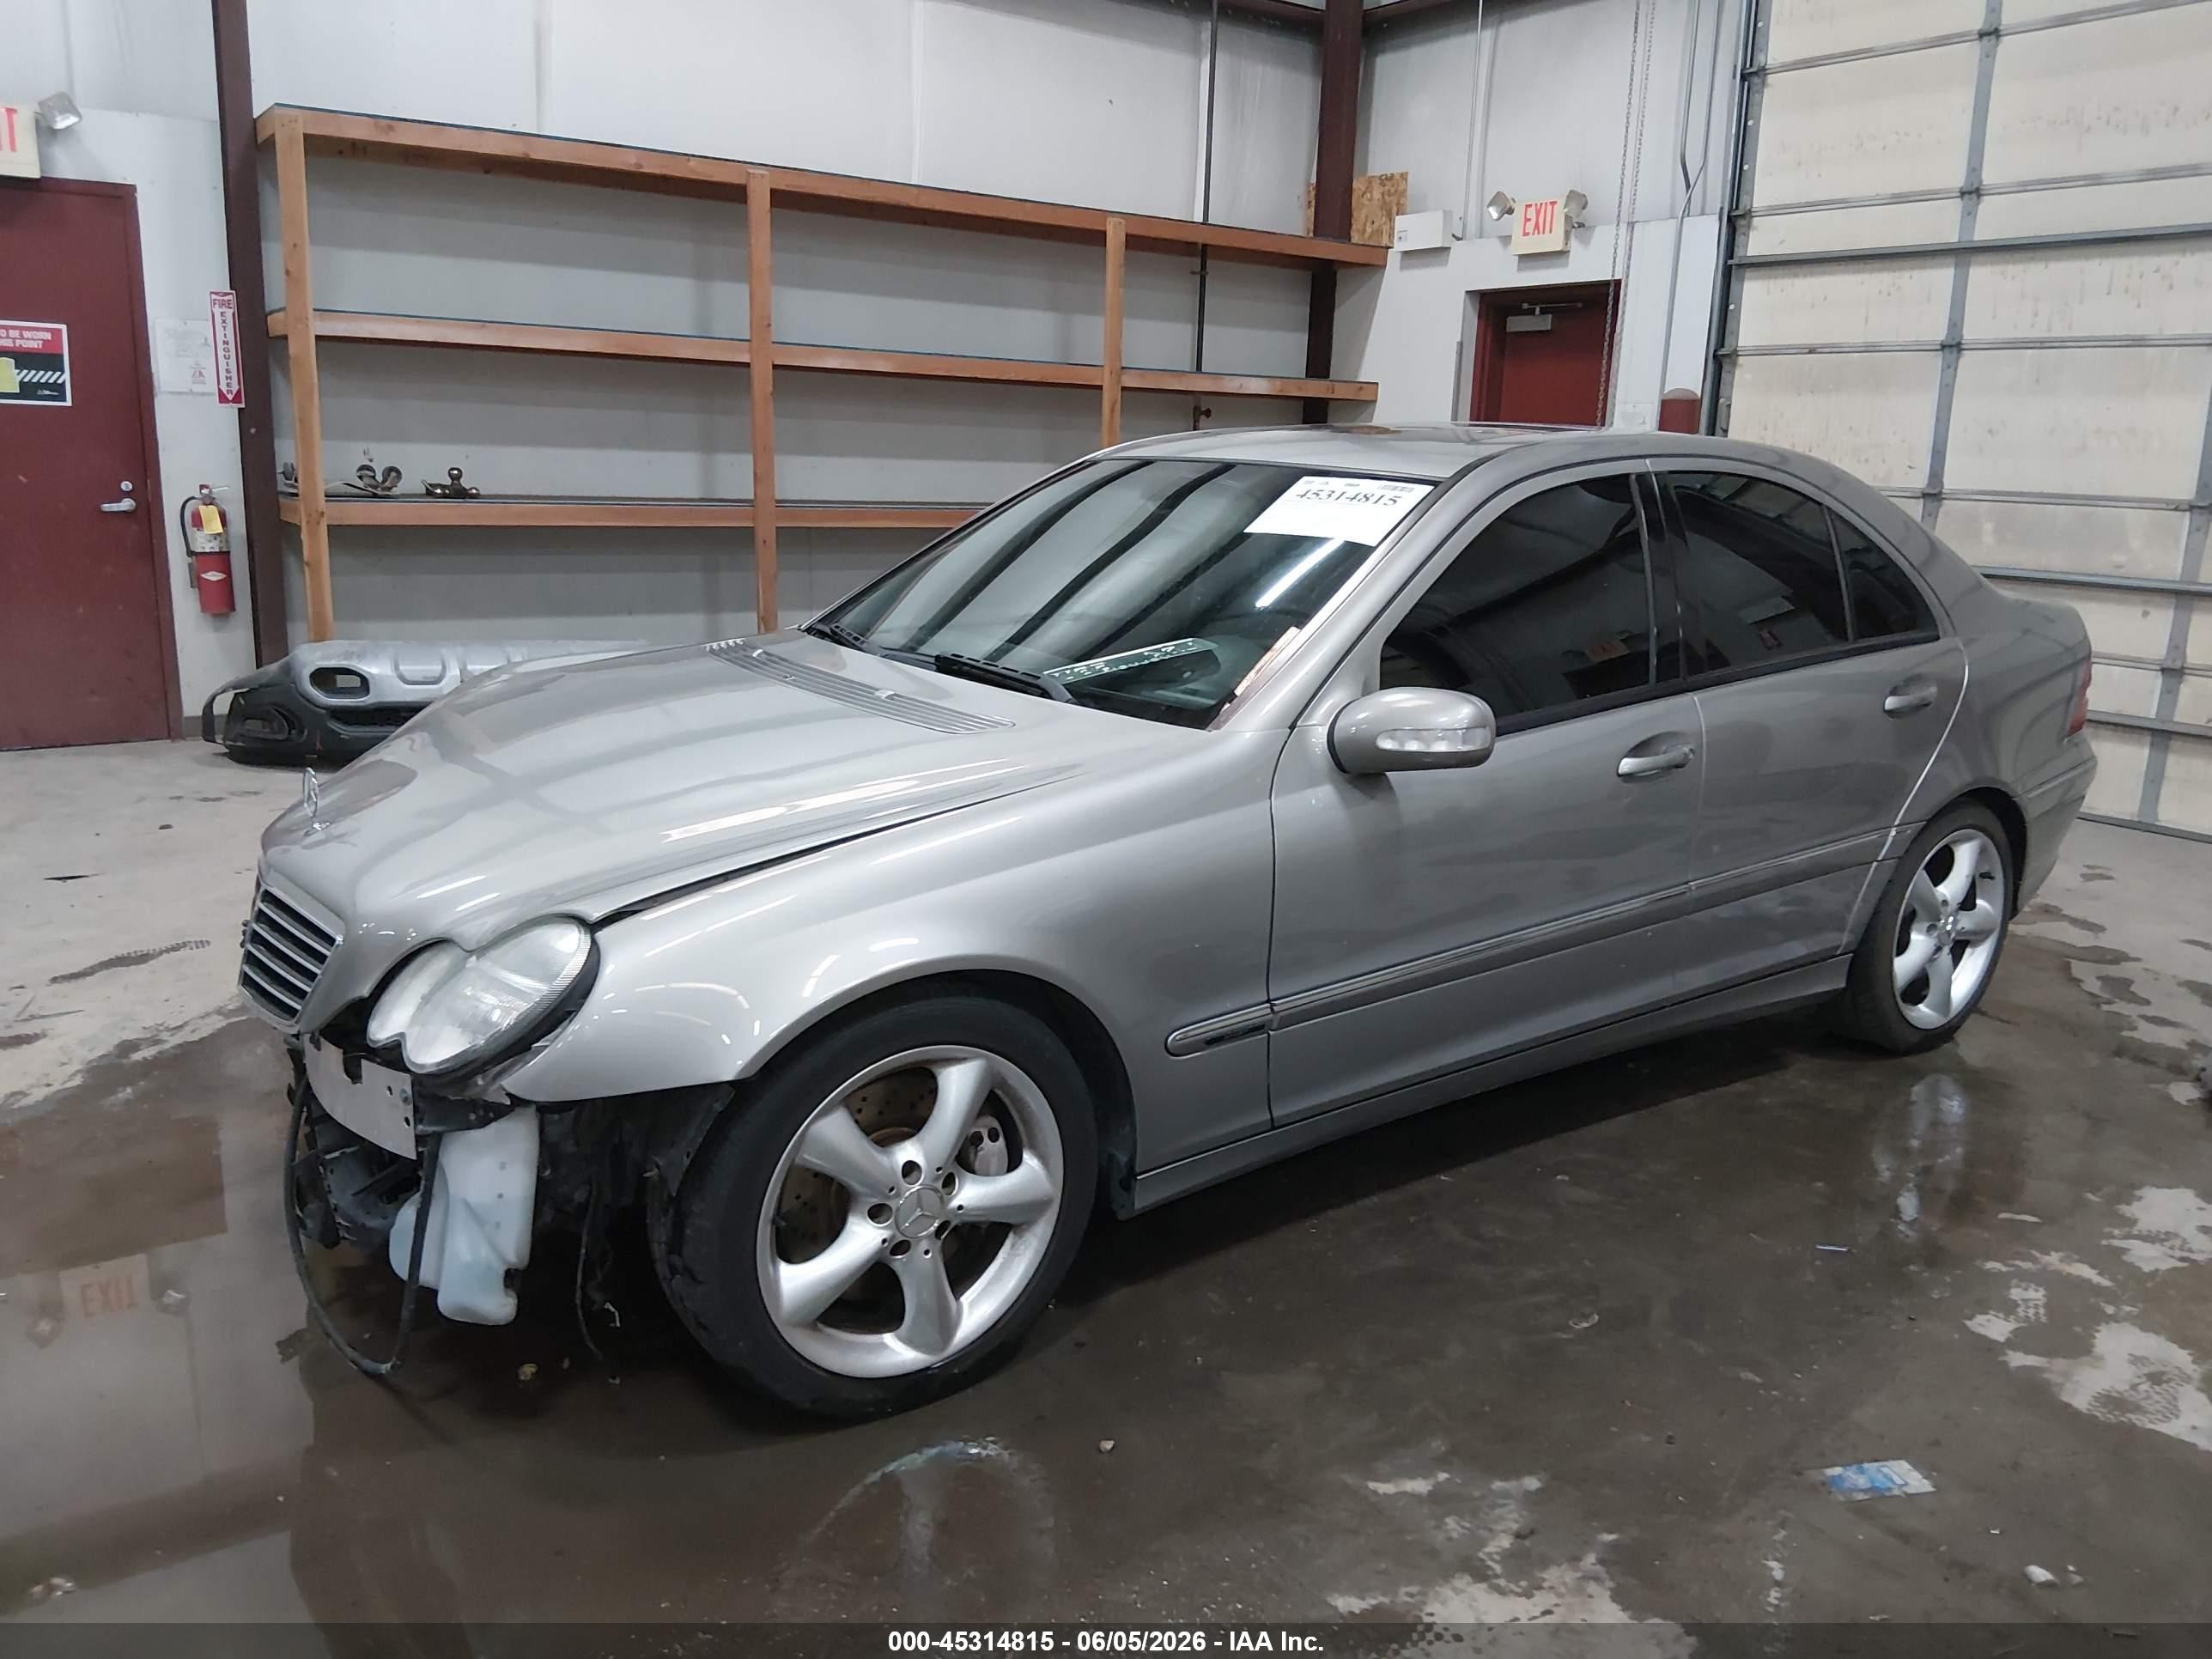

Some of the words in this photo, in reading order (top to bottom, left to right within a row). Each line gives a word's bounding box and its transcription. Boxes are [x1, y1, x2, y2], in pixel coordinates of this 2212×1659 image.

[1522, 201, 1558, 236] EXIT
[212, 299, 234, 309] FIRE
[9, 329, 21, 338] BE
[15, 339, 43, 349] POINT
[220, 311, 234, 396] EXTINGUISHER
[1296, 489, 1402, 507] 45314815
